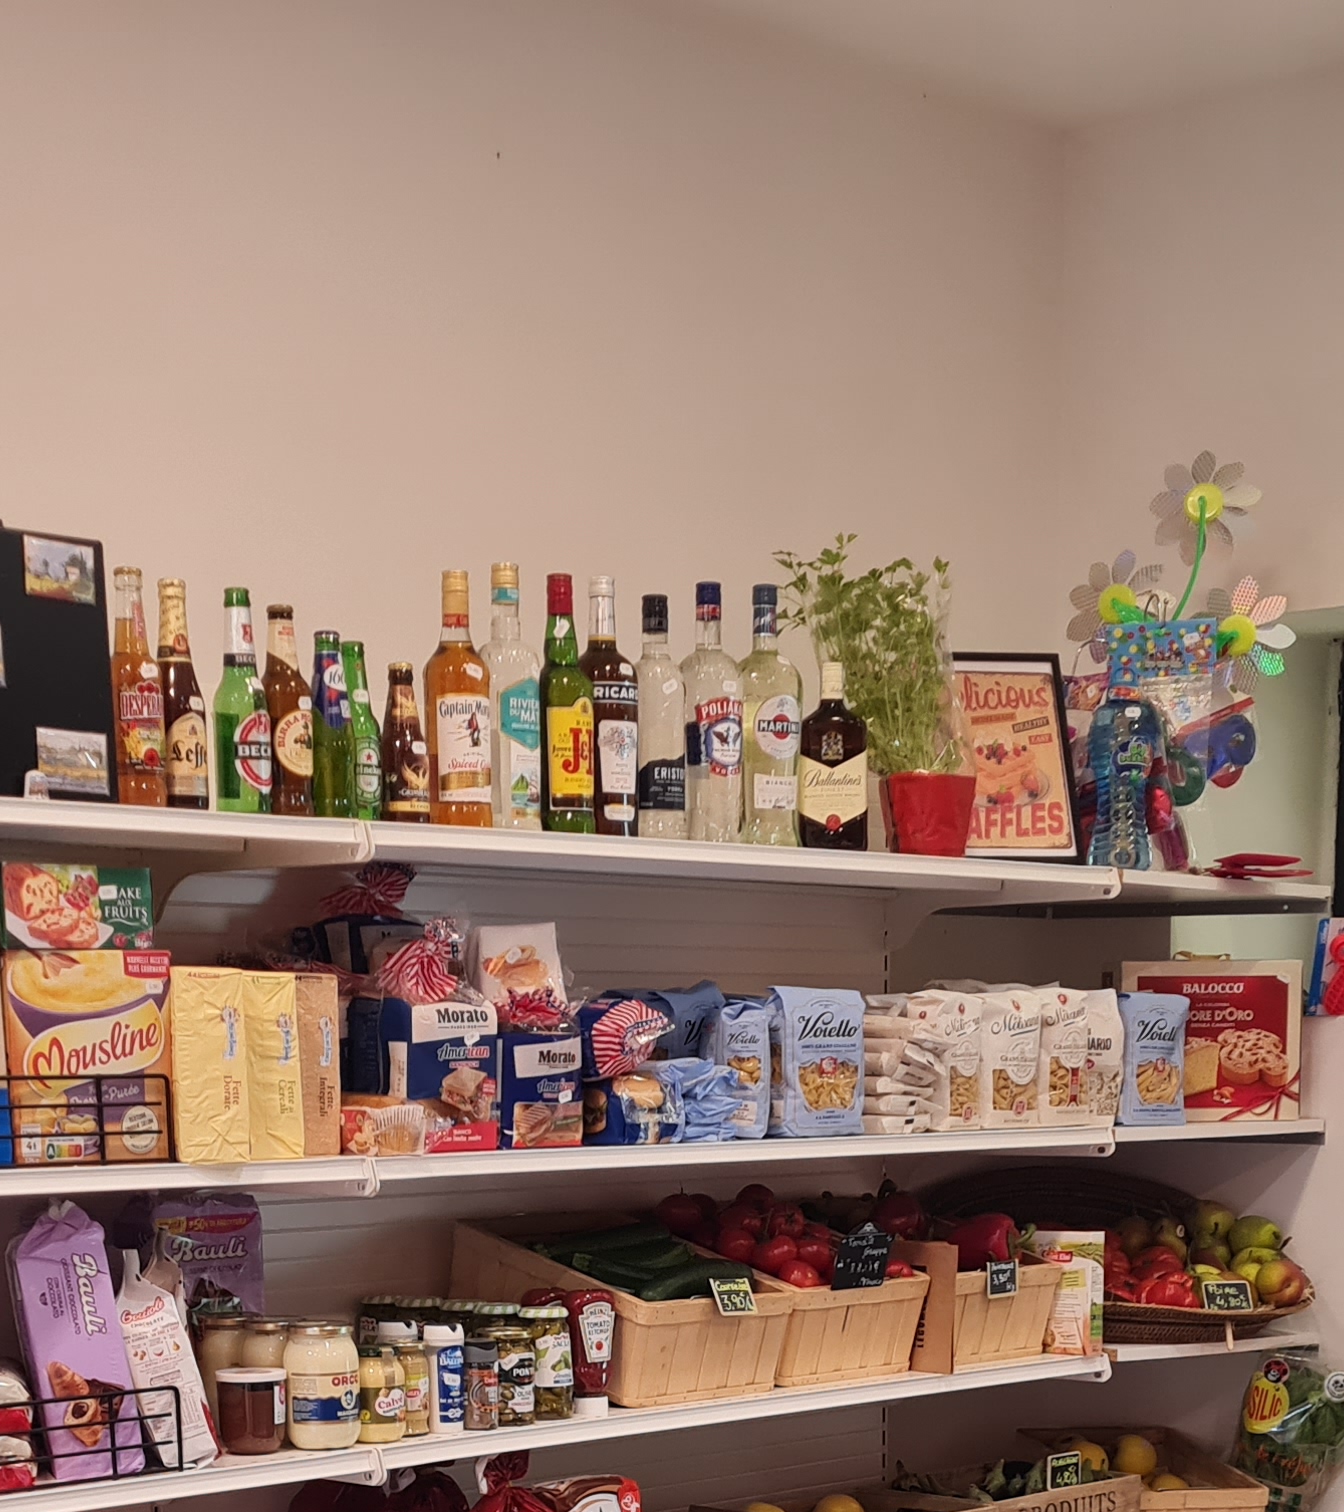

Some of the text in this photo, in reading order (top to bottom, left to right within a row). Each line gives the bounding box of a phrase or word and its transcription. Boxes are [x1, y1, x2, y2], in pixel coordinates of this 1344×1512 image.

[439, 700, 468, 717] Captain
[758, 720, 799, 732] MARTINI
[1030, 734, 1051, 744] EASY
[805, 769, 862, 787] Ballantine's
[967, 802, 1064, 840] AFFLES
[116, 886, 142, 901] AKE
[104, 904, 148, 919] FRUITS
[1182, 982, 1245, 995] BALOCCO
[436, 1007, 489, 1025] Morato
[797, 1010, 859, 1041] Voiello
[32, 1021, 158, 1089] Mousline
[538, 1050, 576, 1064] Morato
[170, 1235, 248, 1262] Bauli
[71, 1252, 108, 1337] Bauli
[586, 1319, 612, 1329] TOMATO
